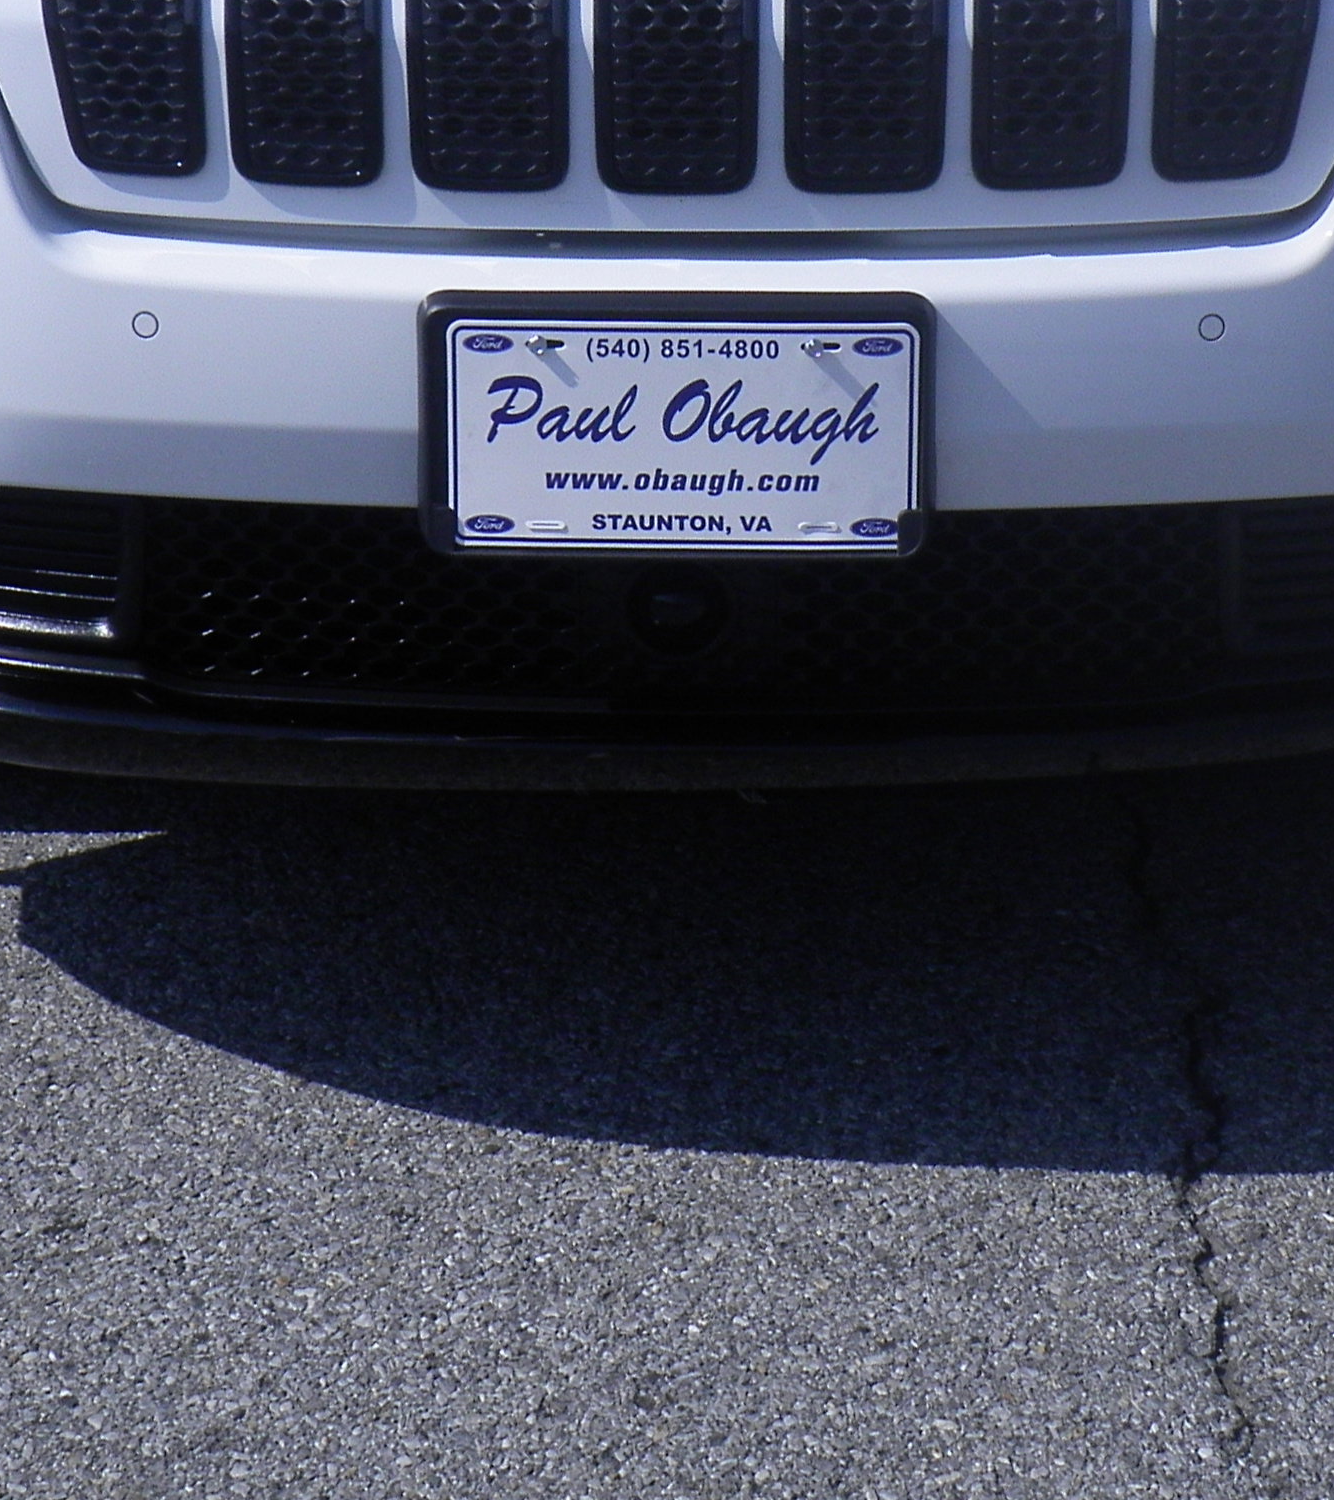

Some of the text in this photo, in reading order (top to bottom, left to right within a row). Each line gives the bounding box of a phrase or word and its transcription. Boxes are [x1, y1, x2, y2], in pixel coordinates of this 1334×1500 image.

[586, 338, 780, 362] (540) 851-4800
[487, 376, 879, 465] Paul Obaugh
[545, 468, 819, 494] www.obaugh.com
[592, 514, 773, 534] STAUNTON, VA
